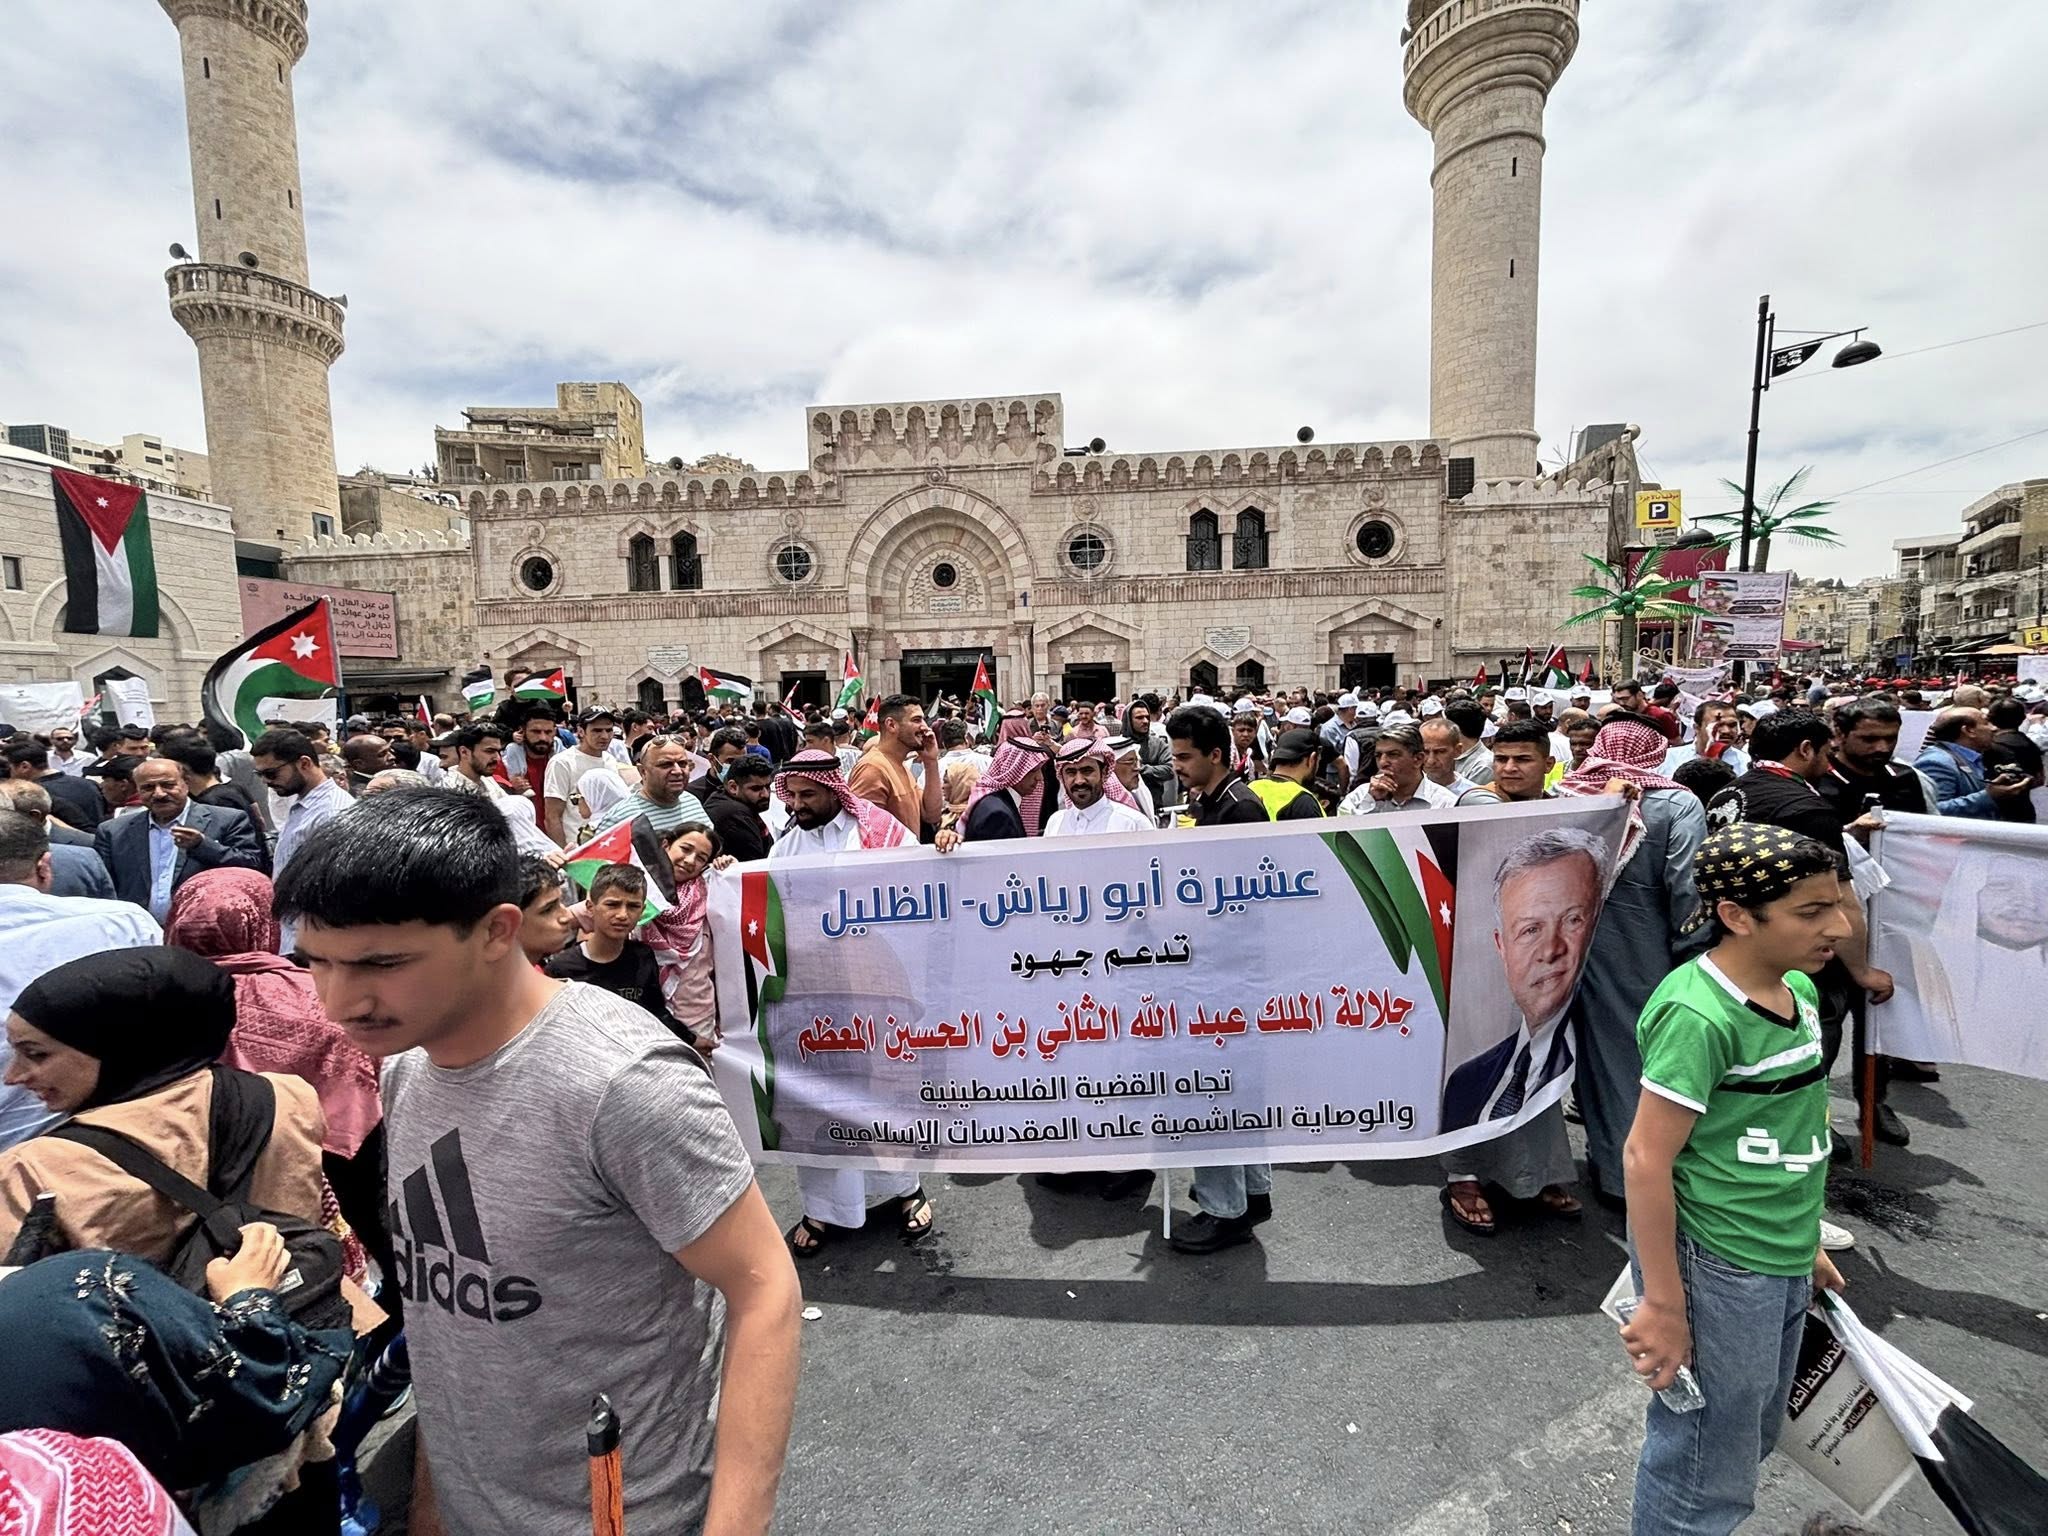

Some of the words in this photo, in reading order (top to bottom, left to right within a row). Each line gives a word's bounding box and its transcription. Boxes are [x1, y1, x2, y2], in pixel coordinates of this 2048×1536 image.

[1651, 503, 1666, 518] P
[1103, 858, 1161, 921] أبو
[1176, 856, 1320, 916] عشيرة
[821, 882, 950, 937] الظليل
[1010, 949, 1093, 978] جهود
[1104, 934, 1191, 975] تدعم
[1037, 992, 1119, 1061] الثاني
[1187, 1003, 1247, 1047] عبد
[1256, 991, 1323, 1034] الملك
[1330, 985, 1414, 1035] جلالة
[798, 1013, 875, 1062] المعظم
[884, 1010, 980, 1061] الحسين
[991, 1010, 1027, 1059] بن
[920, 1076, 1066, 1109] الفلسطينية
[1075, 1072, 1166, 1105] القضية
[1174, 1069, 1232, 1099] تجاه
[828, 1119, 940, 1150] الإسلامية
[948, 1117, 1078, 1146] المقدسات
[1087, 1115, 1144, 1139] على
[1151, 1106, 1283, 1141] الهاشمية
[1291, 1100, 1415, 1134] والوصاية
[393, 1236, 542, 1324] didas
[1816, 1338, 1843, 1373] قدس
[1802, 1367, 1823, 1389] خط
